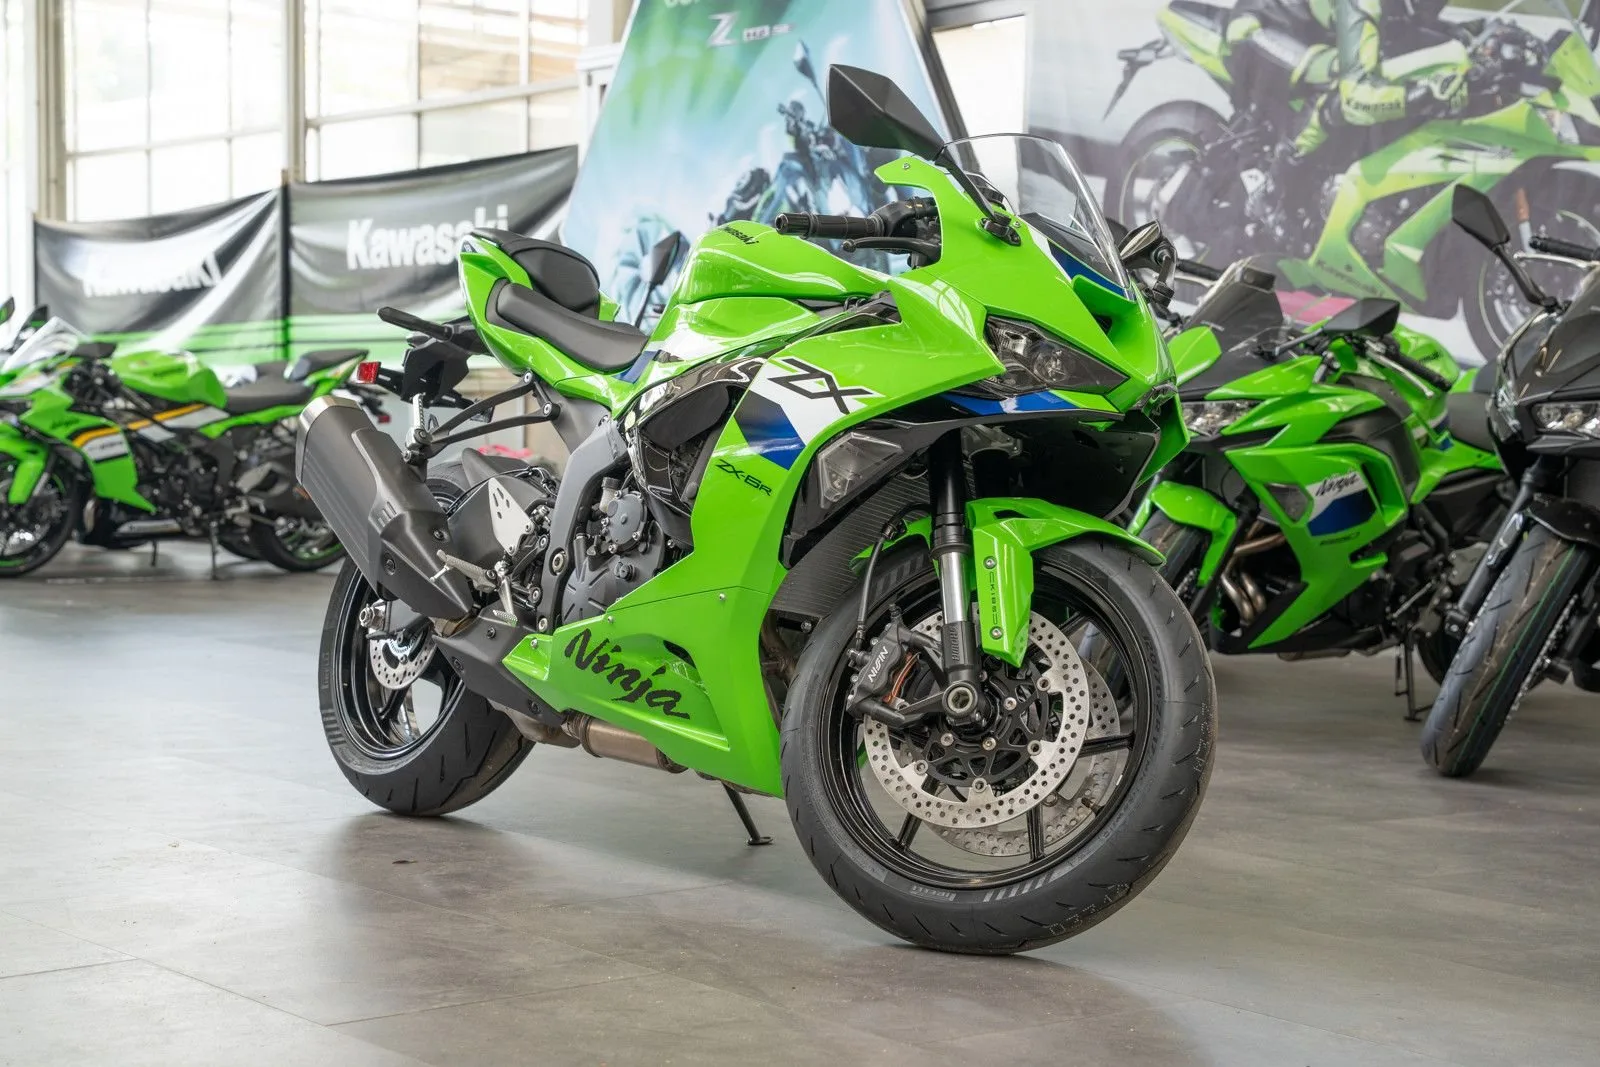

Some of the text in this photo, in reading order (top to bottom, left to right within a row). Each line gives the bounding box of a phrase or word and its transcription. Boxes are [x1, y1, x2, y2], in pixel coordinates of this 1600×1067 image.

[767, 357, 875, 416] ZX
[715, 458, 774, 497] ZX-6R
[564, 627, 691, 720] Ninja
